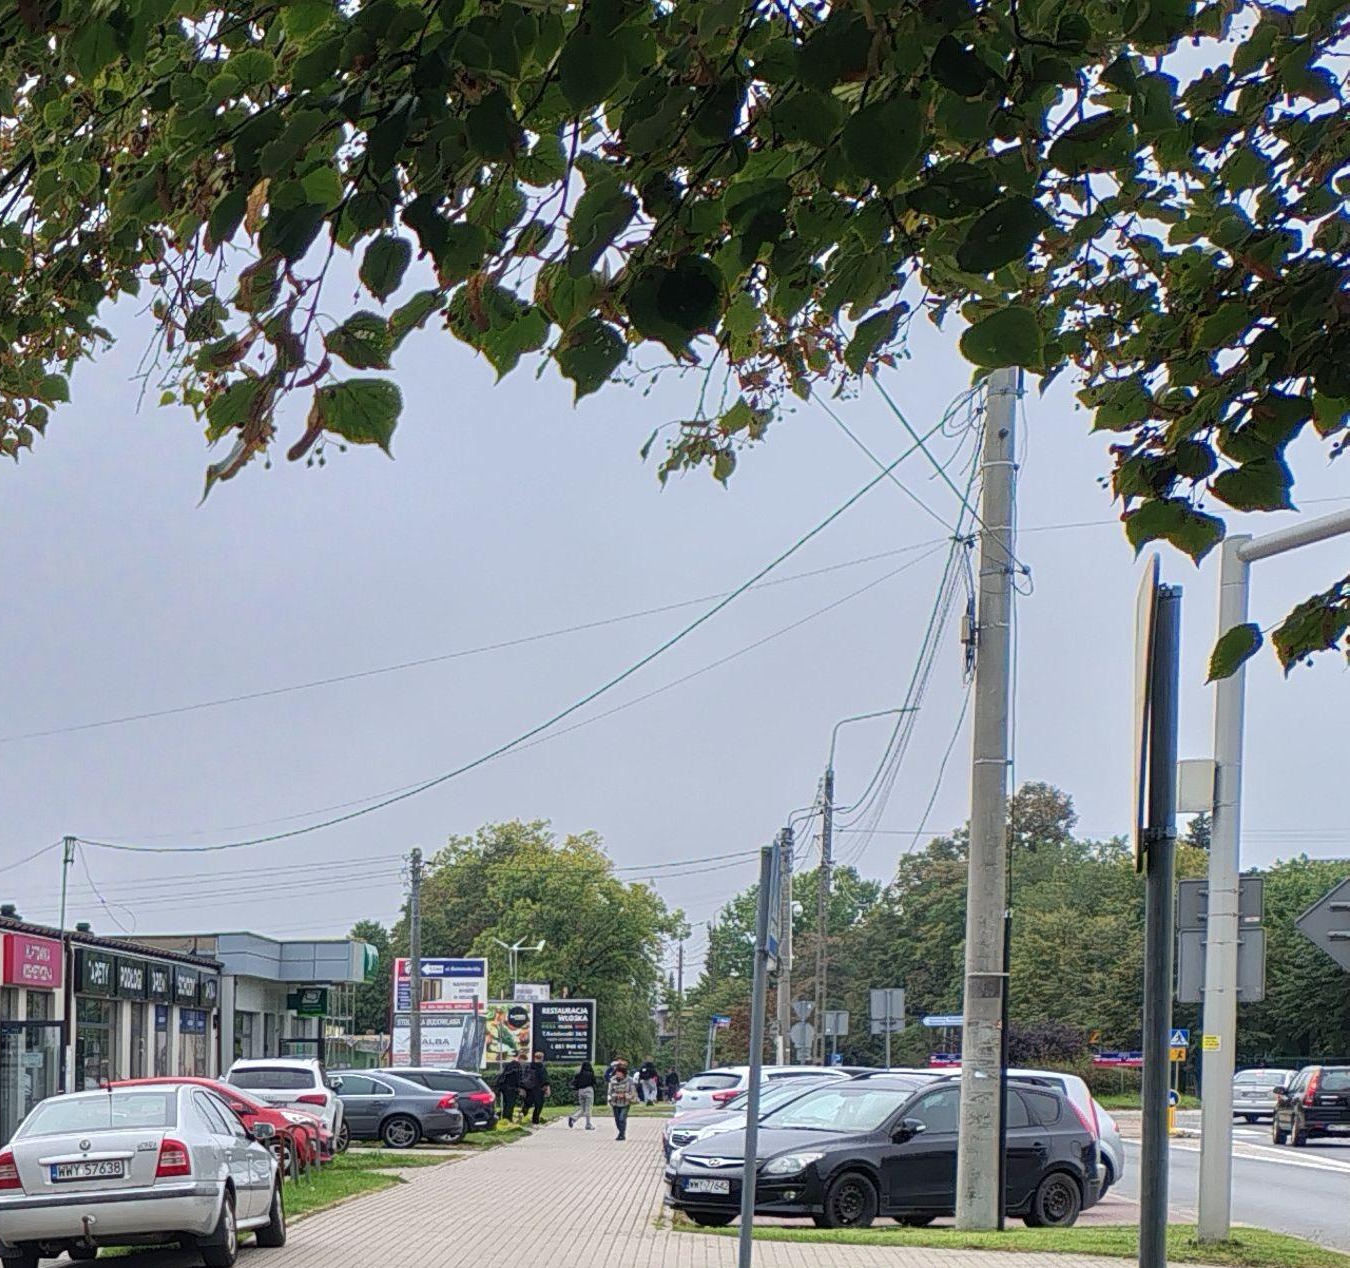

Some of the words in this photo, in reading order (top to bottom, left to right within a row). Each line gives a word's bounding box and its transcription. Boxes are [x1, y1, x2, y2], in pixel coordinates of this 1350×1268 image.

[541, 1007, 588, 1015] RESTAURACJA
[557, 1014, 588, 1022] WŁOSKA
[57, 1164, 80, 1177] WWY
[85, 1161, 121, 1175] 57638
